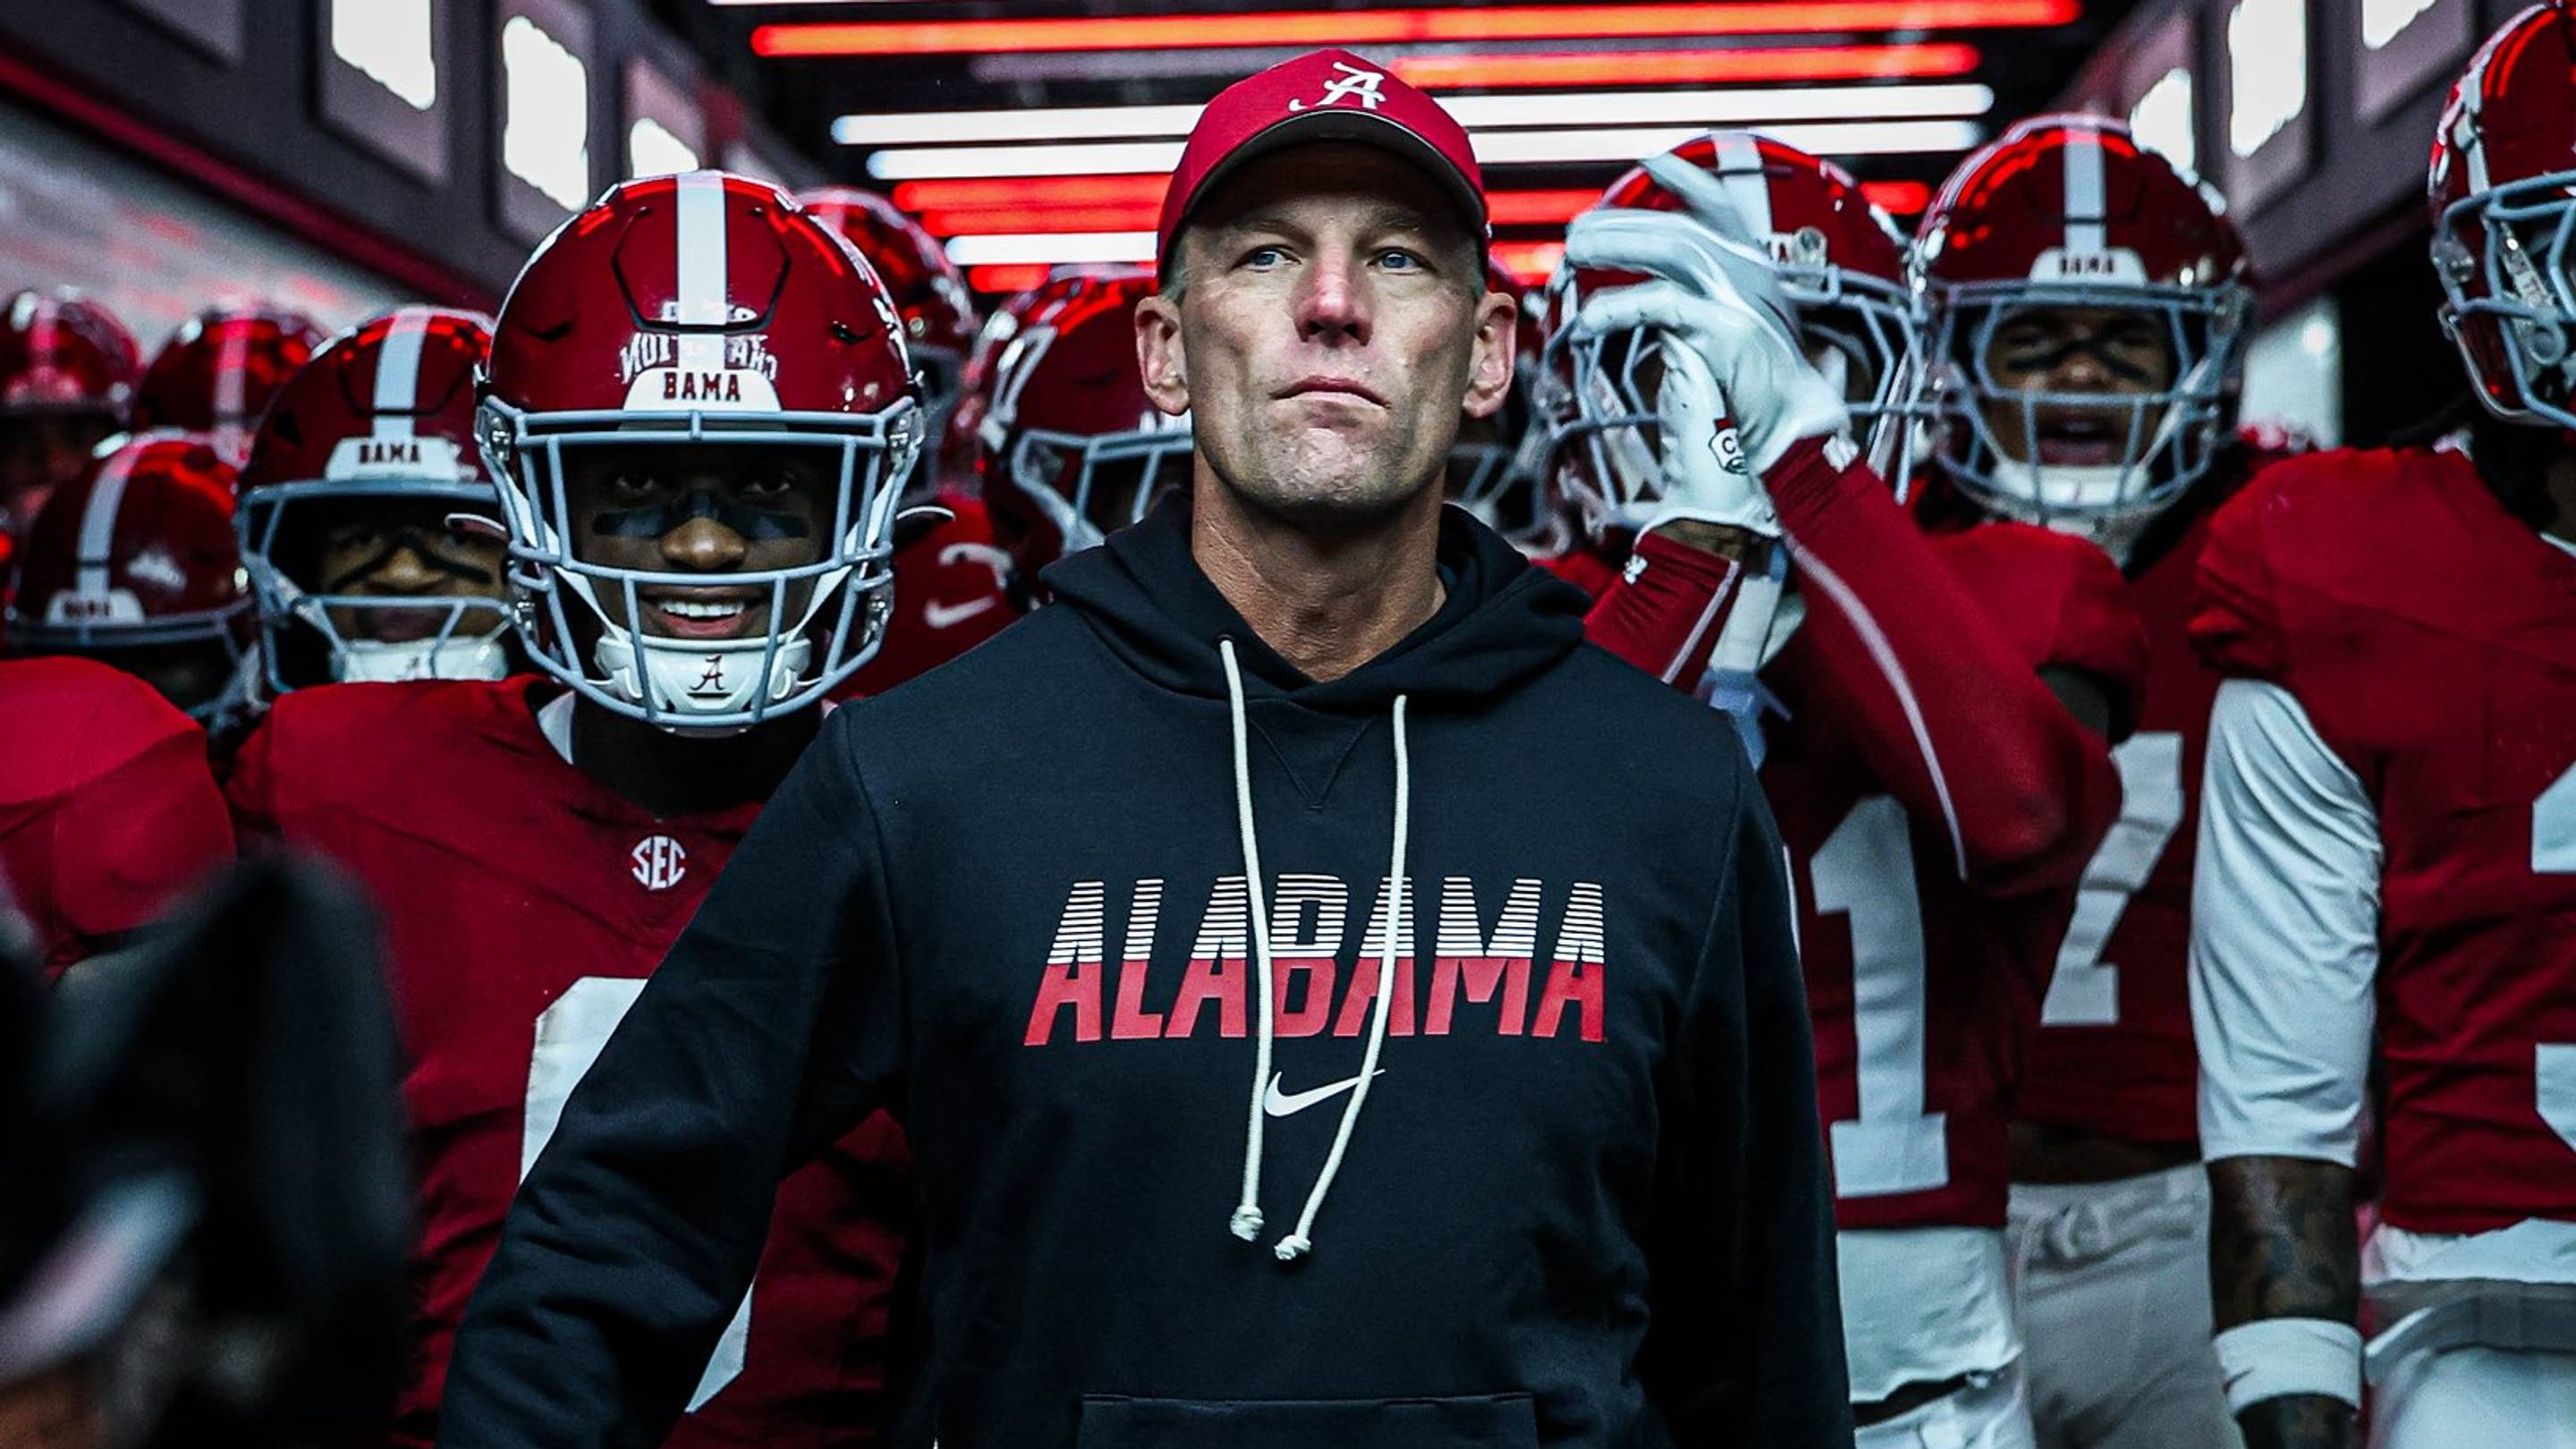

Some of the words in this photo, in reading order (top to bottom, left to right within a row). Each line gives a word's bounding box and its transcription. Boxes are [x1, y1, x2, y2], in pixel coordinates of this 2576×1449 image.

[1289, 61, 1386, 112] A
[664, 371, 741, 402] BAMA
[690, 654, 725, 691] A
[631, 835, 686, 890] SEC
[1023, 873, 1606, 1047] ALABAMA
[1811, 794, 1950, 1199] 1
